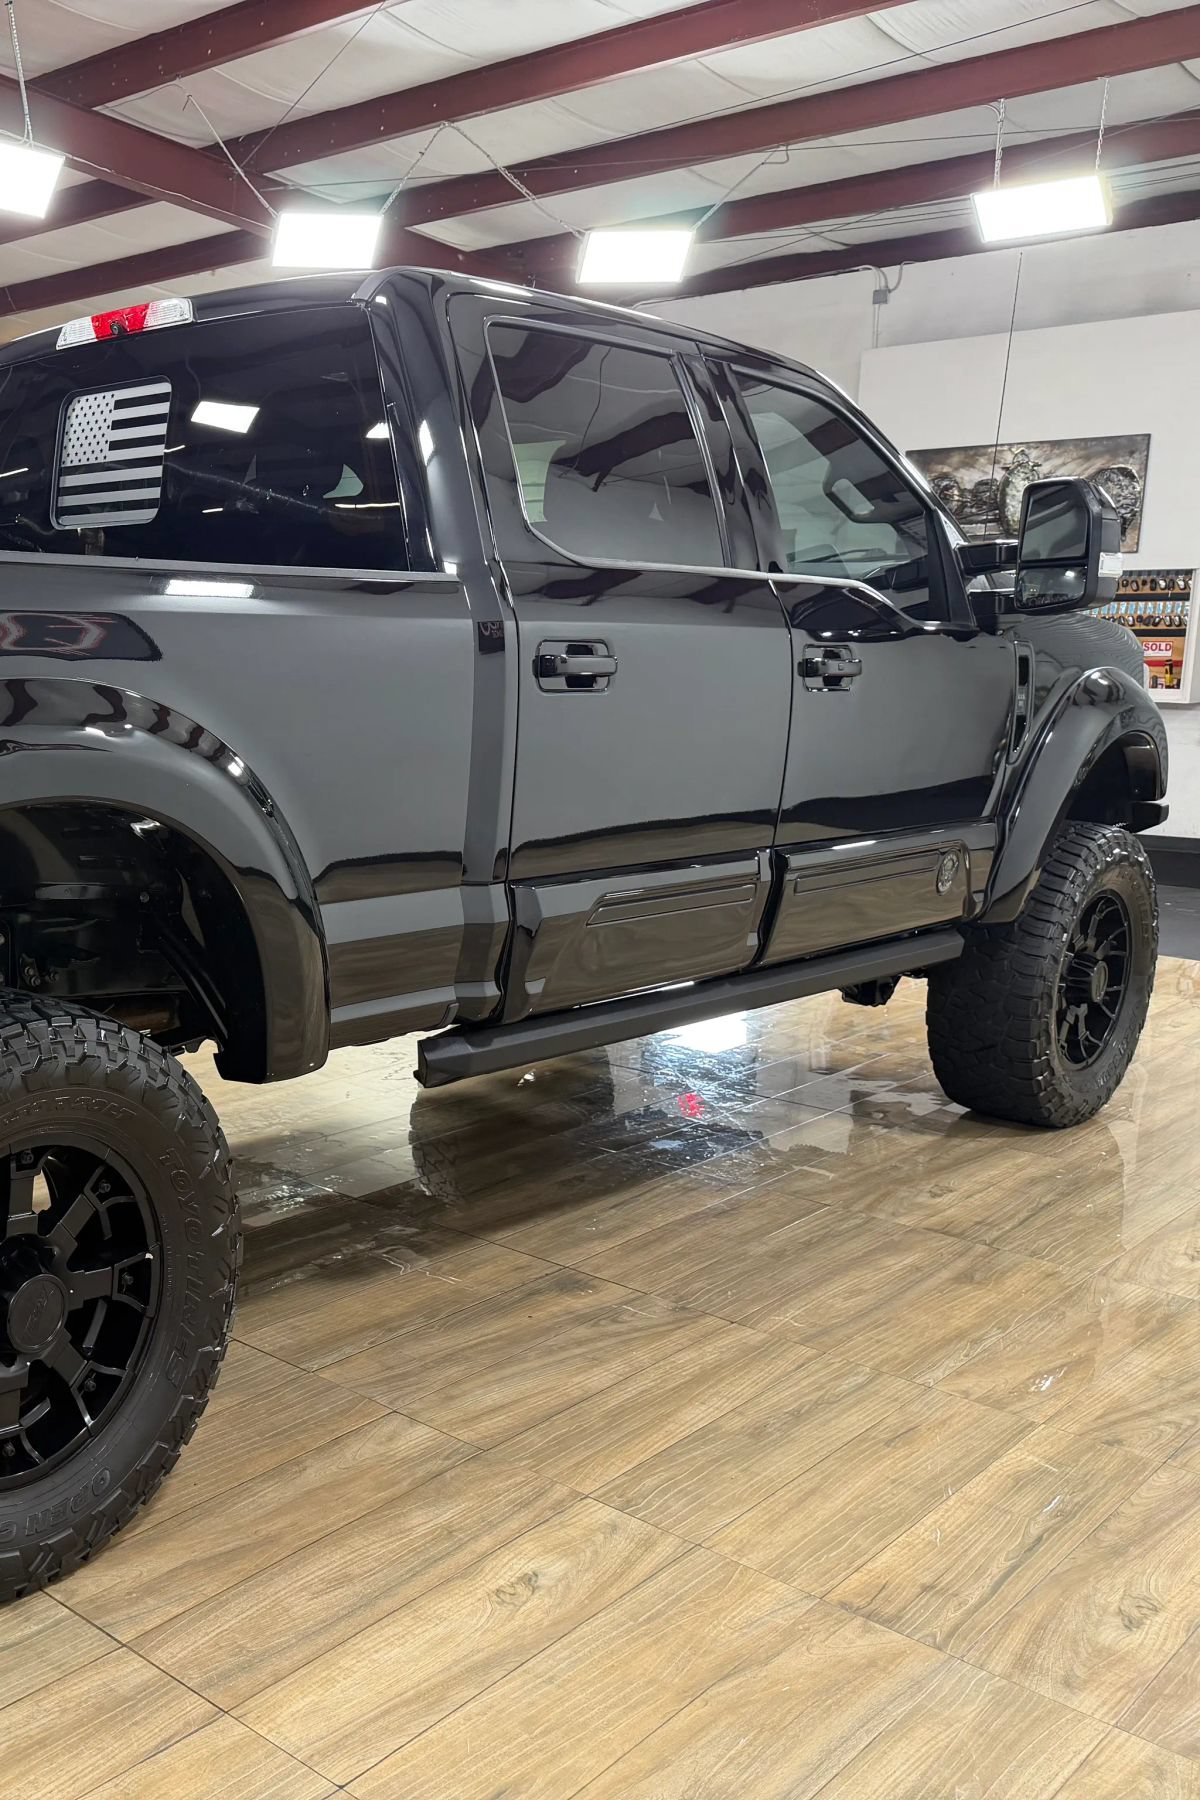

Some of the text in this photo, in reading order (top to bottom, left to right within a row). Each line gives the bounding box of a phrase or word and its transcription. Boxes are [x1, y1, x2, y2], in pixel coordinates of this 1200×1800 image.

[1144, 642, 1172, 652] SOLD
[159, 1147, 203, 1245] TOYO
[24, 1467, 112, 1537] OPEN
